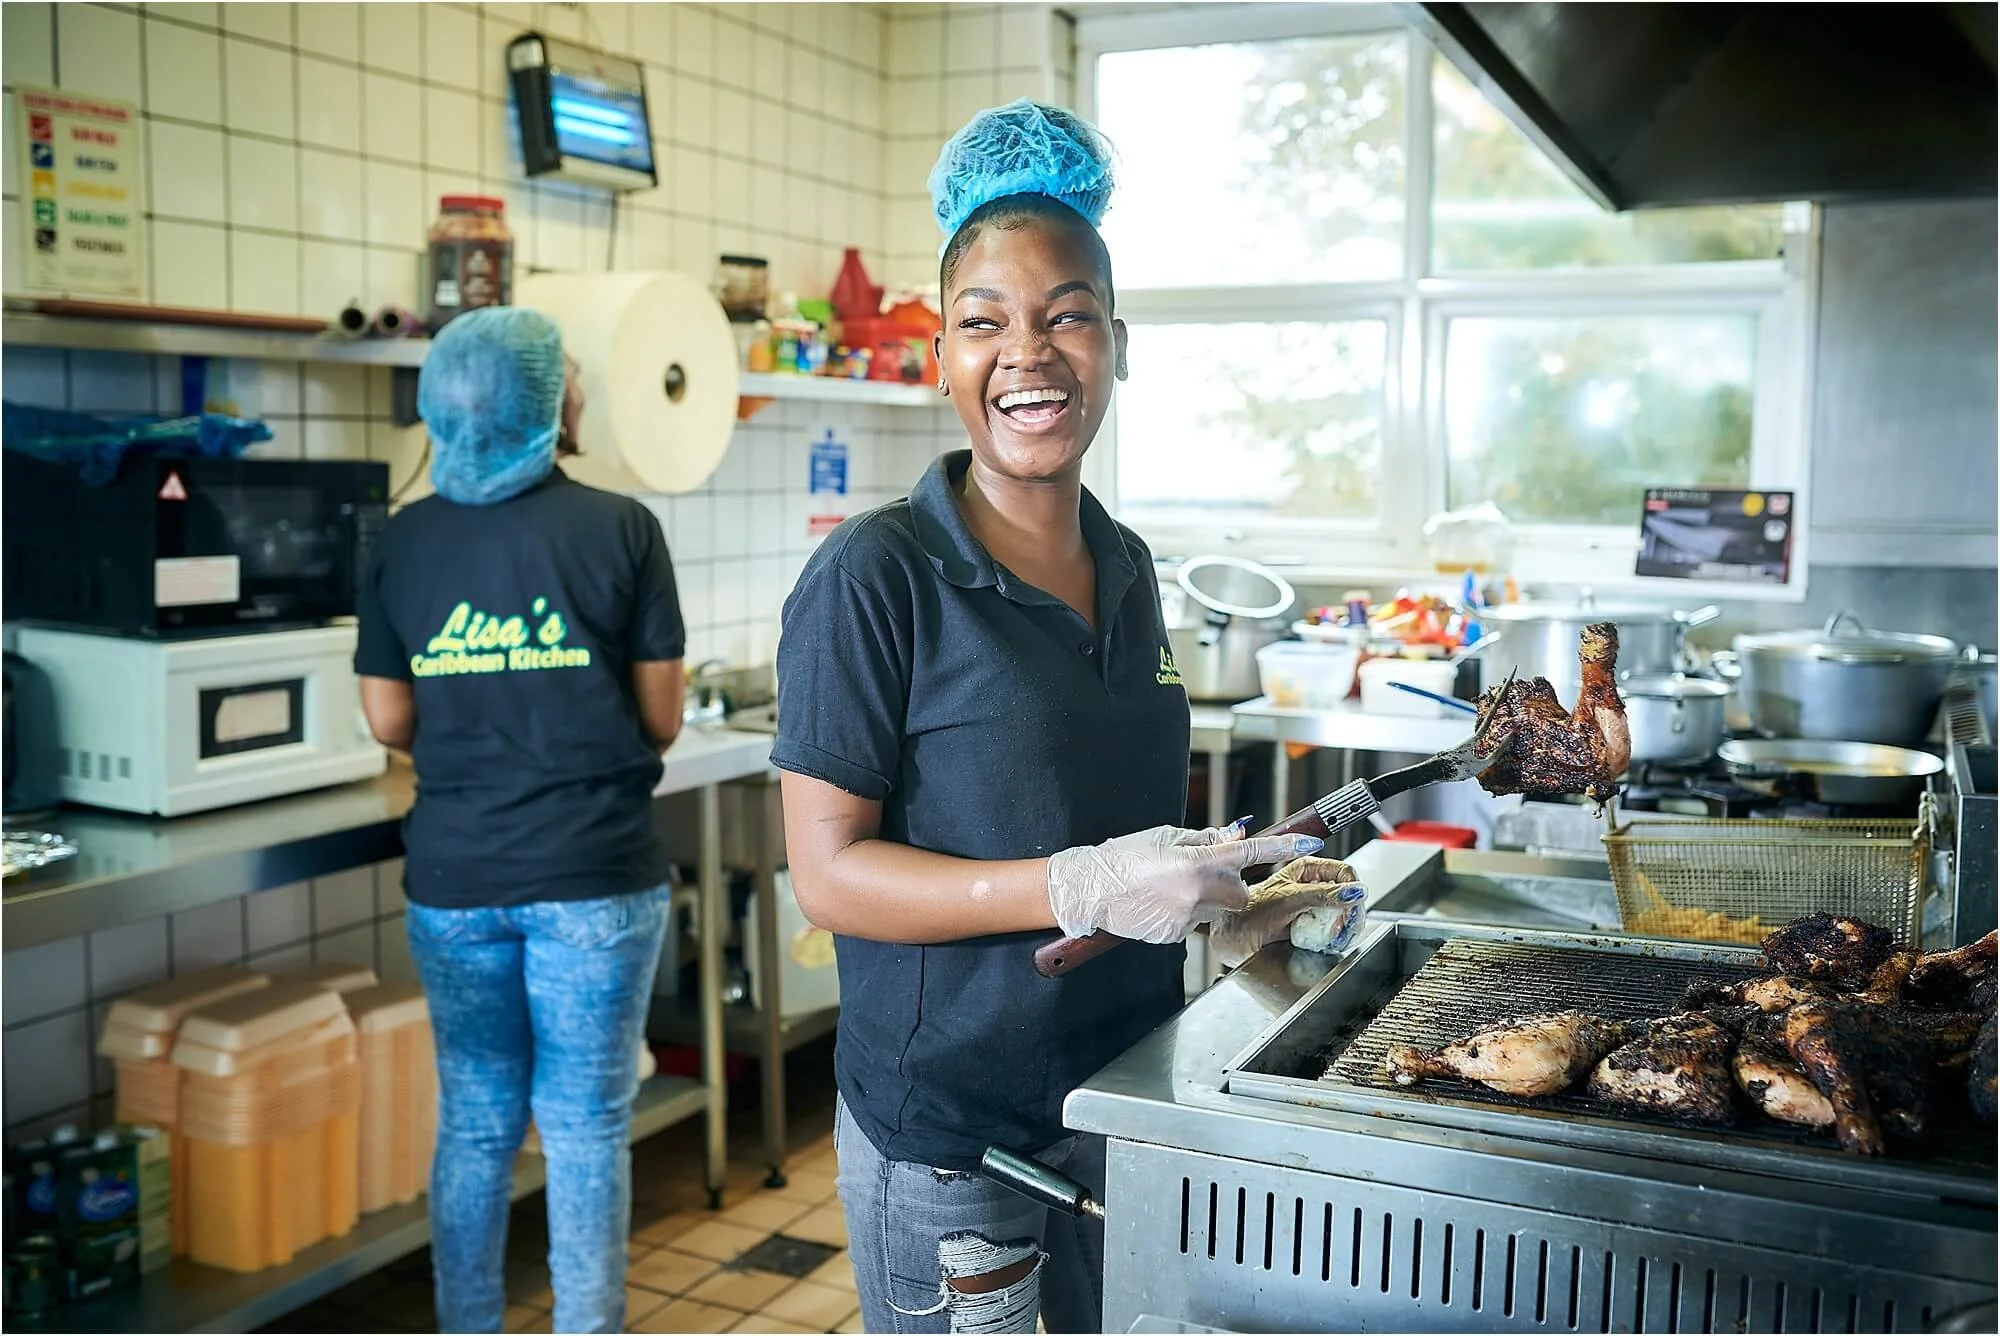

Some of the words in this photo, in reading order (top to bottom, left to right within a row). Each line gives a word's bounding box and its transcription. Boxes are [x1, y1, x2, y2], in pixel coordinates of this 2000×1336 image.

[427, 597, 566, 652] Lisa's
[411, 652, 505, 677] Caribbean
[508, 646, 590, 670] Kitchen
